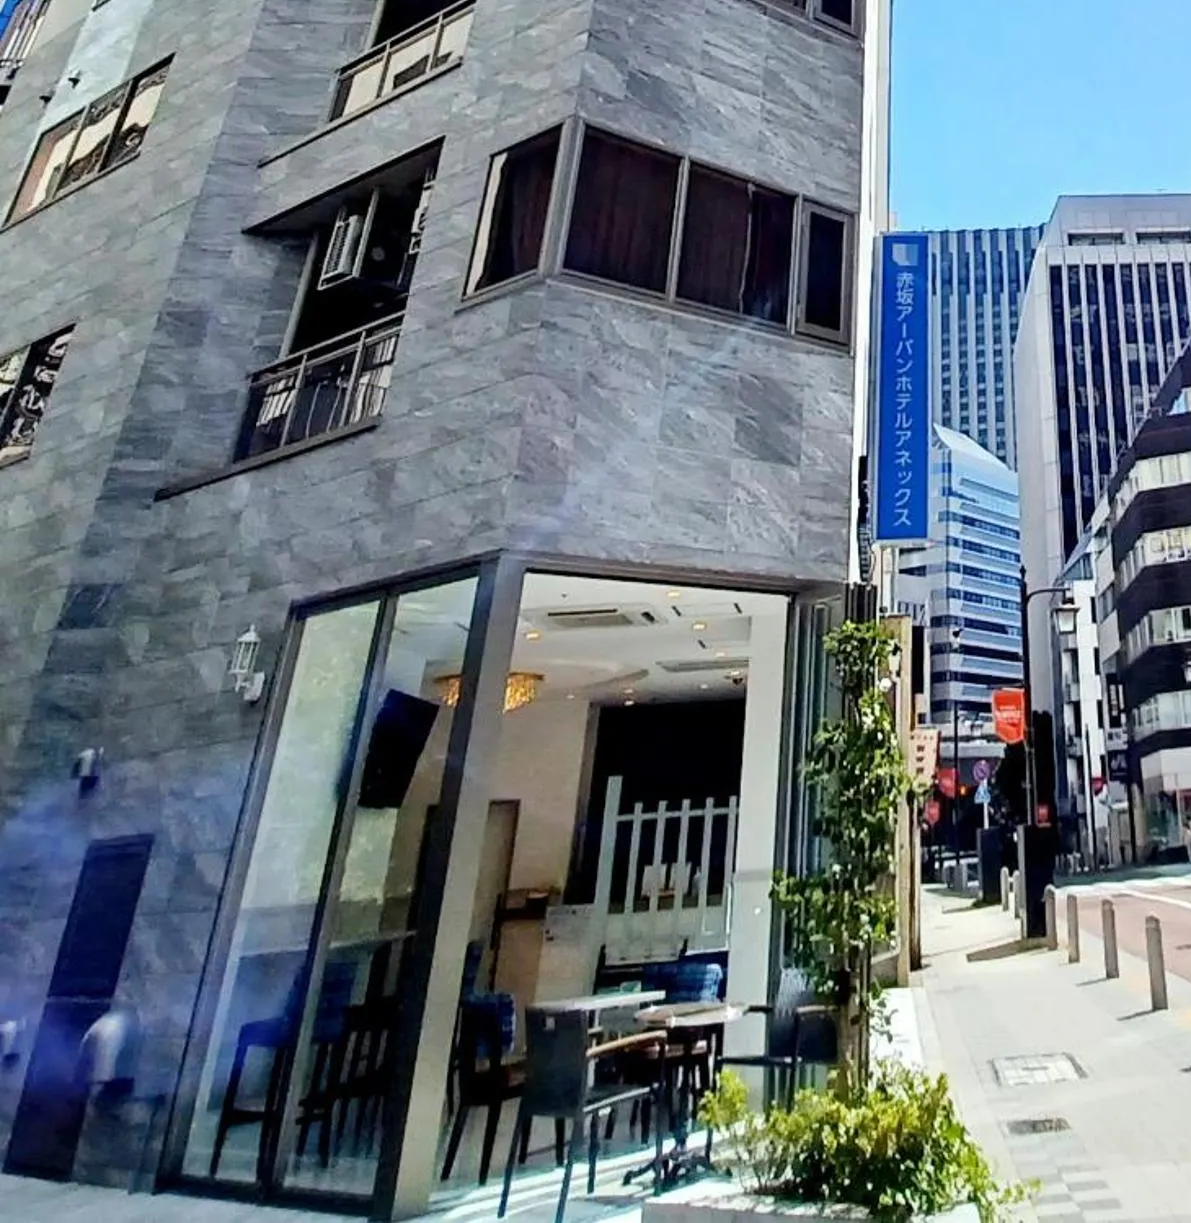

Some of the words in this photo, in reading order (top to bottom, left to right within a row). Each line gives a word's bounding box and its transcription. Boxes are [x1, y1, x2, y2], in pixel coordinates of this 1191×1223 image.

[894, 272, 915, 526] 赤坂アーバンホテルアネックス
